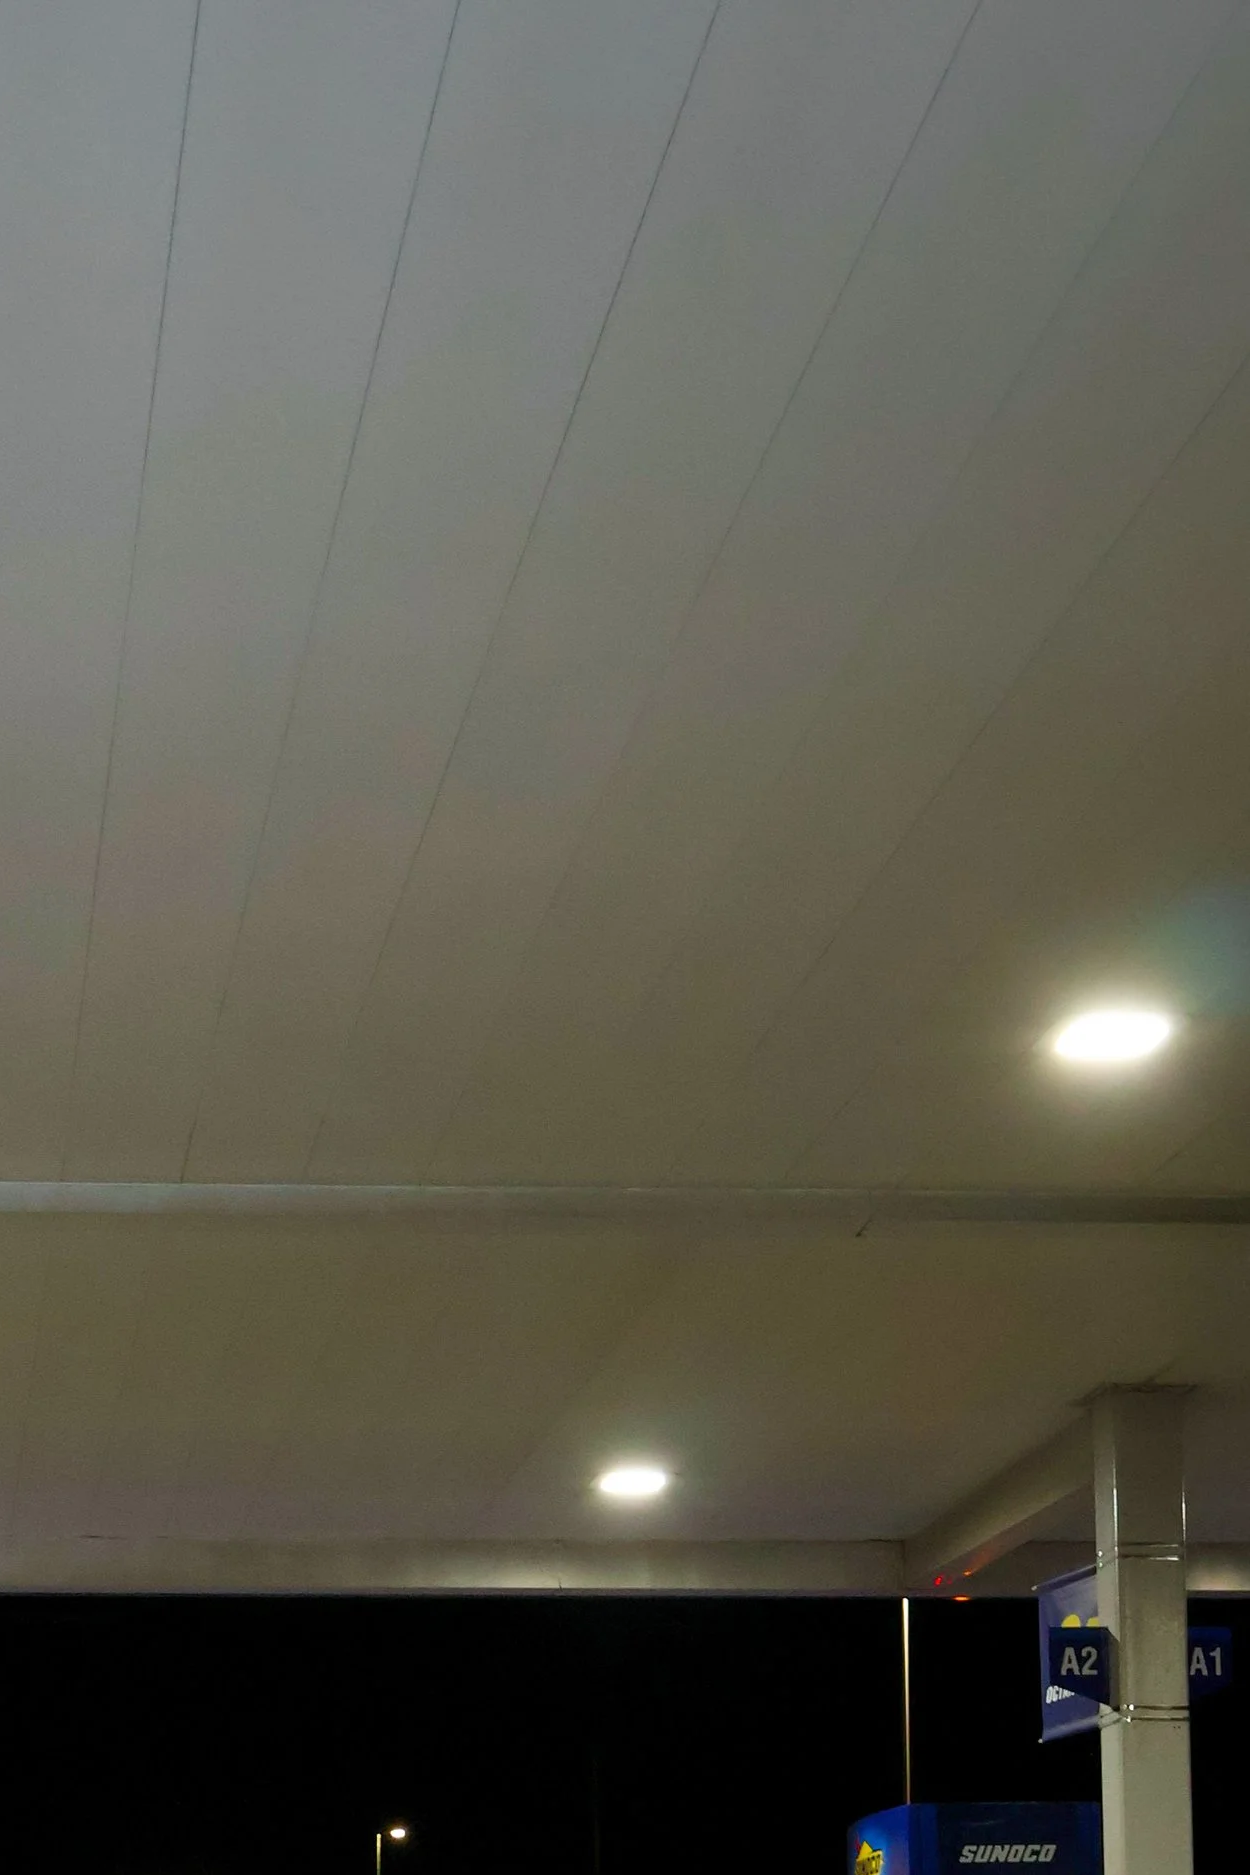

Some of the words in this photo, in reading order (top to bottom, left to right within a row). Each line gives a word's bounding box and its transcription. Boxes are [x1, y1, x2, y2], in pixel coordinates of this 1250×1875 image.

[1060, 1646, 1098, 1676] A2
[1189, 1646, 1222, 1676] A1
[959, 1844, 1057, 1863] SUNOCO
